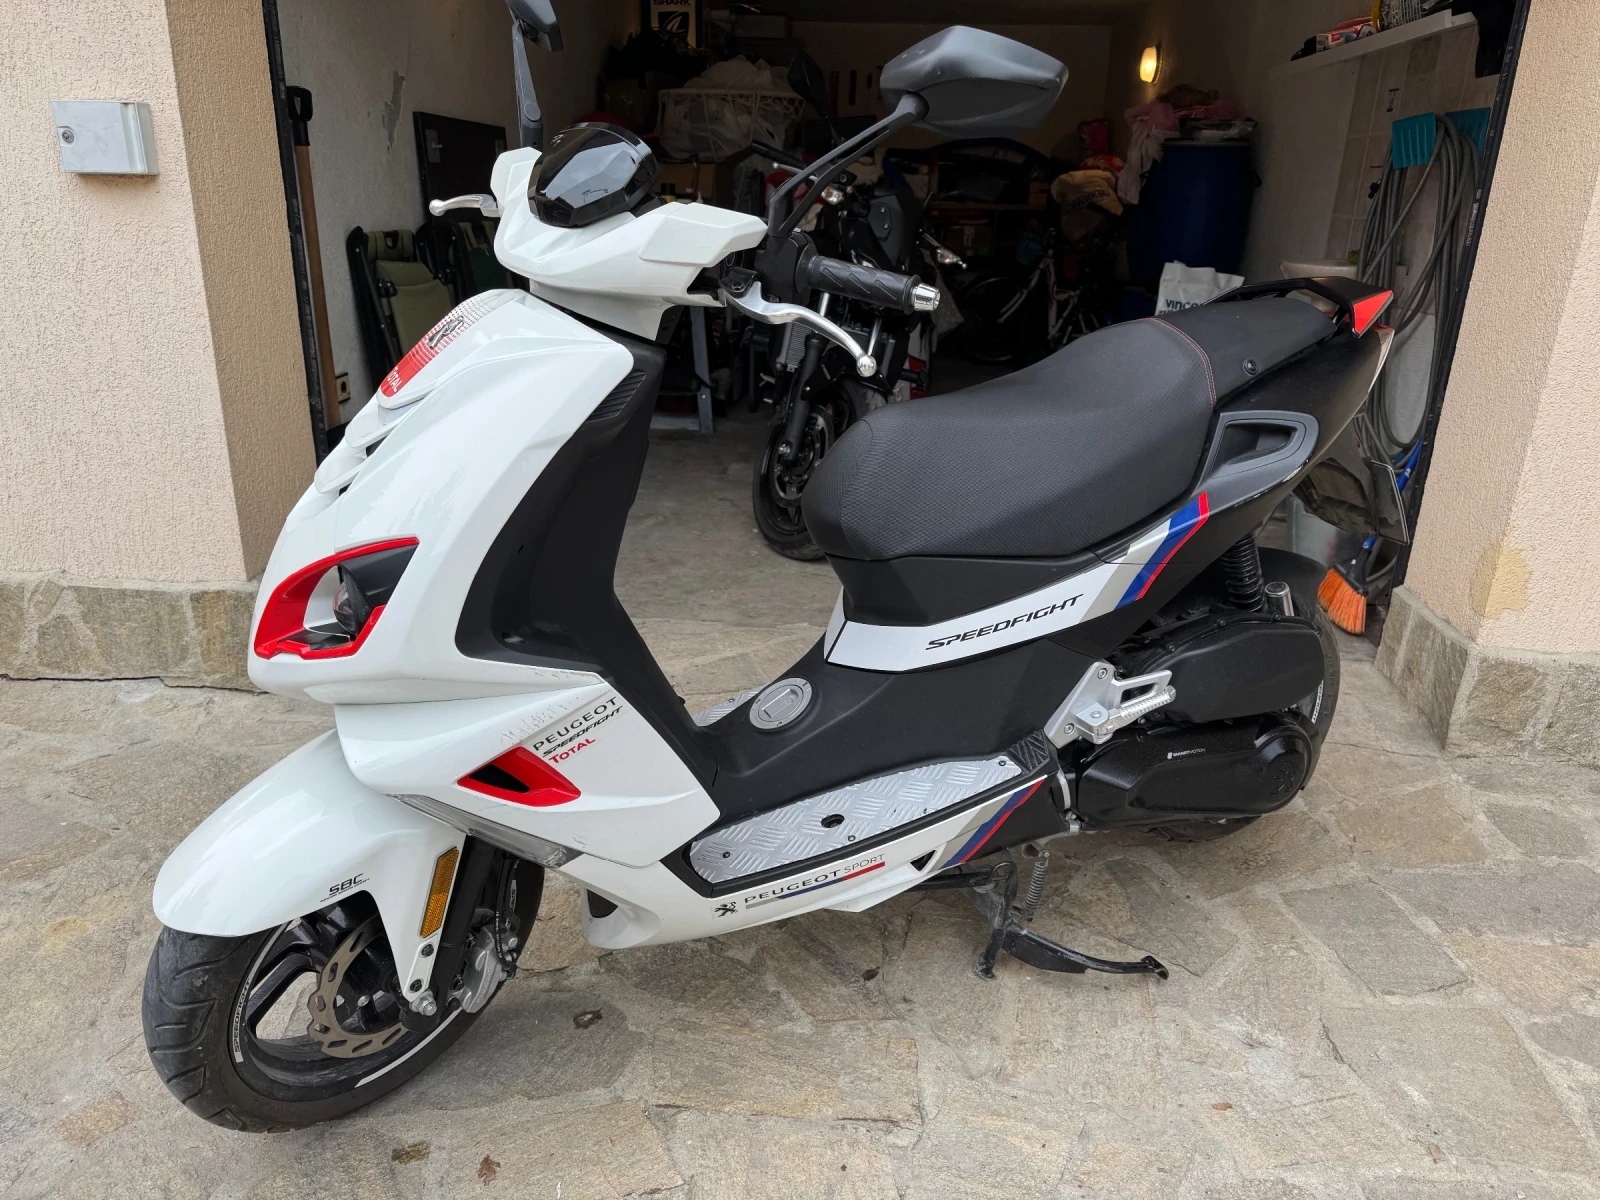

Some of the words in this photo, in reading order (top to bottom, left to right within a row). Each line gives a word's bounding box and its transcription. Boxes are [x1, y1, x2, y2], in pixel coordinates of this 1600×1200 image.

[387, 365, 403, 393] TOTAL
[925, 593, 1084, 651] SPEEDFIGHT
[532, 696, 617, 752] PEUGEOT
[542, 704, 624, 758] SPEEDFIGHT
[548, 737, 597, 764] TOTAL
[328, 872, 364, 897] SBC
[744, 868, 842, 904] PEUGEOT
[843, 852, 886, 875] SPORT
